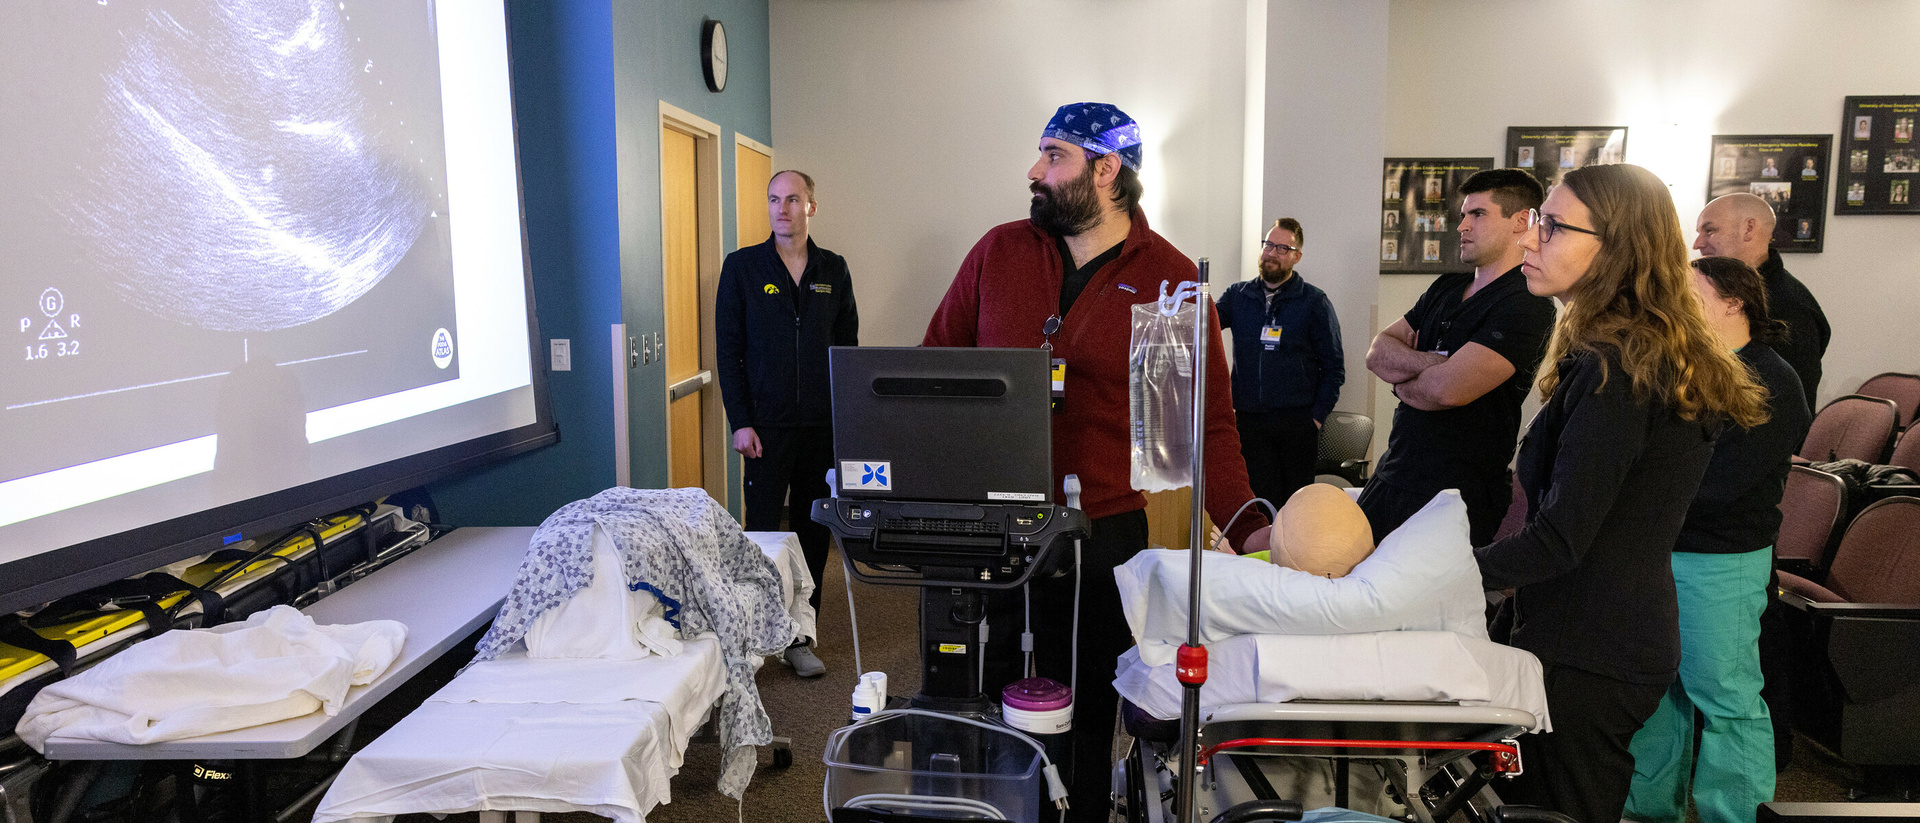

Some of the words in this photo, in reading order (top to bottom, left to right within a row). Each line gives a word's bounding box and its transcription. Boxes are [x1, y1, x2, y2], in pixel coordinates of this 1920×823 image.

[46, 295, 57, 311] G
[20, 316, 32, 333] P
[70, 312, 81, 328] R
[25, 343, 49, 361] 1.6
[56, 339, 80, 357] 3.2
[204, 769, 233, 780] Flexx
